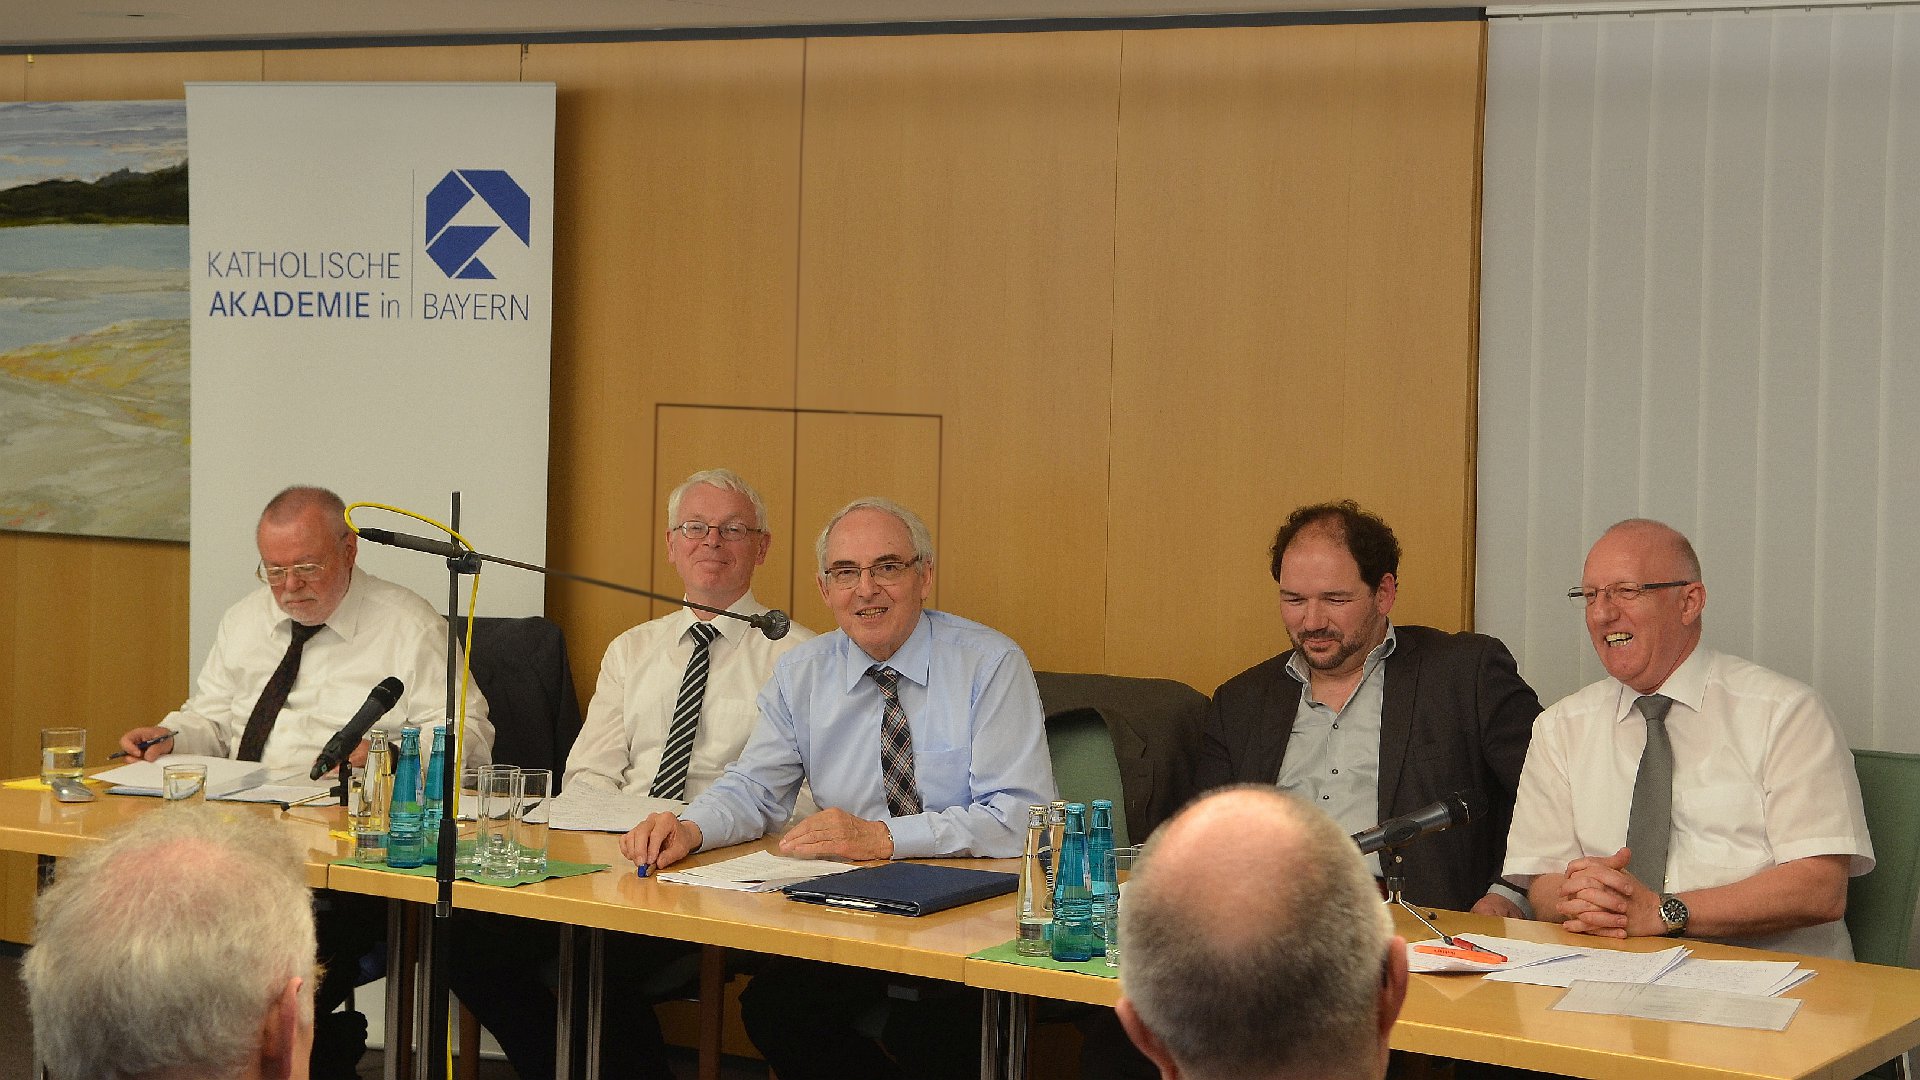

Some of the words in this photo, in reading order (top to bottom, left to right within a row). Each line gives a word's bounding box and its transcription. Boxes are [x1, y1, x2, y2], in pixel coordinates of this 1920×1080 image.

[207, 251, 400, 279] KATHOLISCHE
[208, 291, 370, 318] AKADEMIE
[381, 292, 400, 319] in
[423, 293, 529, 321] BAYERN
